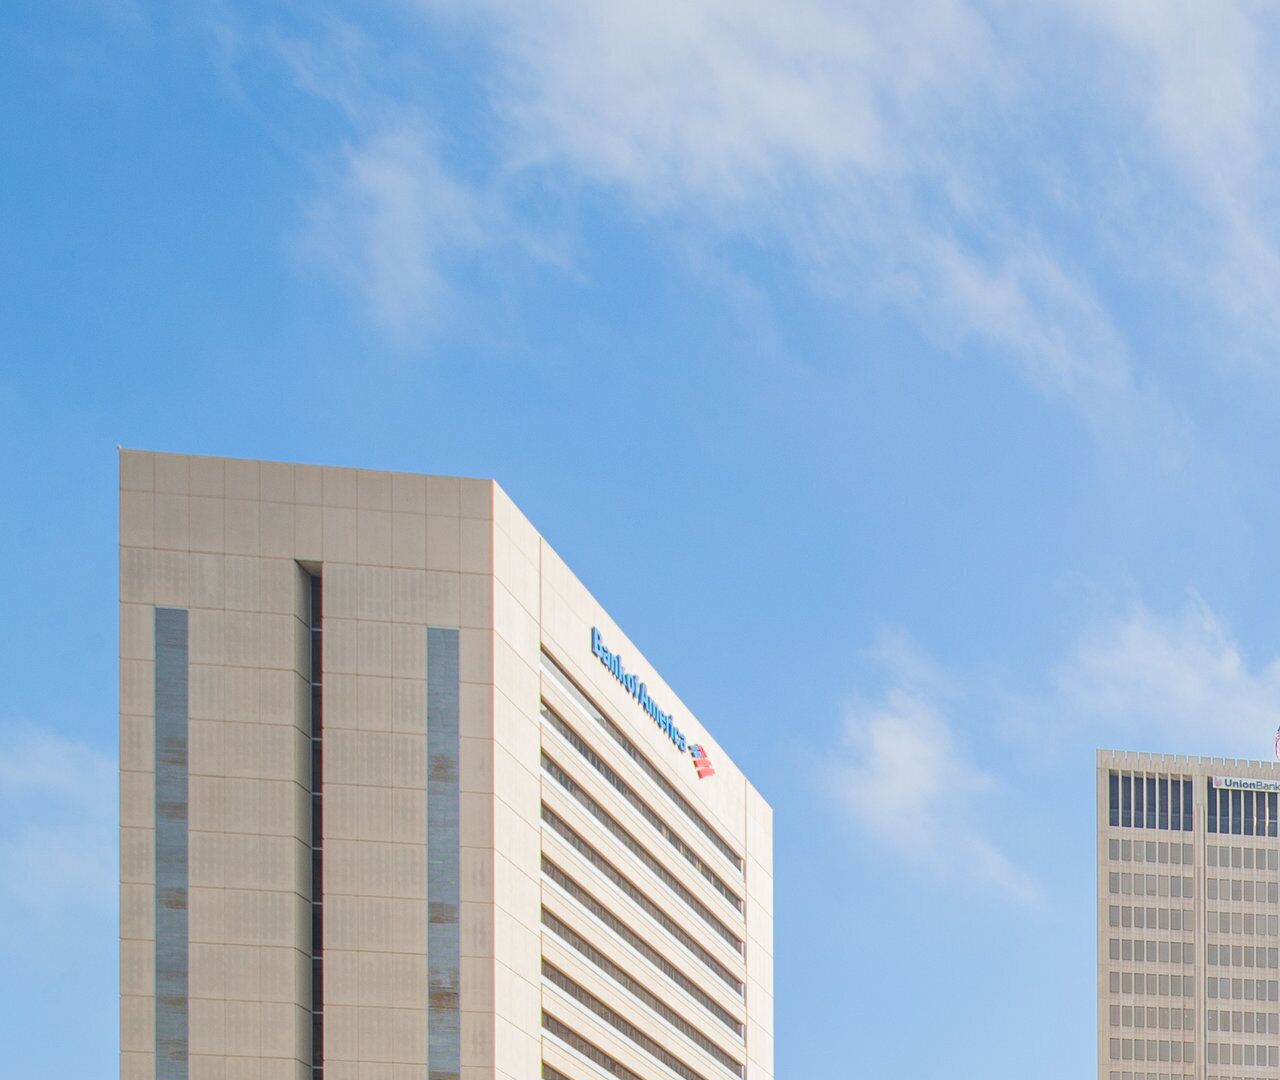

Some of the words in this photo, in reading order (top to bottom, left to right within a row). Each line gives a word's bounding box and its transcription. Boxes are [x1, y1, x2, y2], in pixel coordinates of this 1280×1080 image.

[591, 627, 624, 686] Bank
[638, 683, 686, 752] America
[1225, 779, 1280, 791] UnionBank
